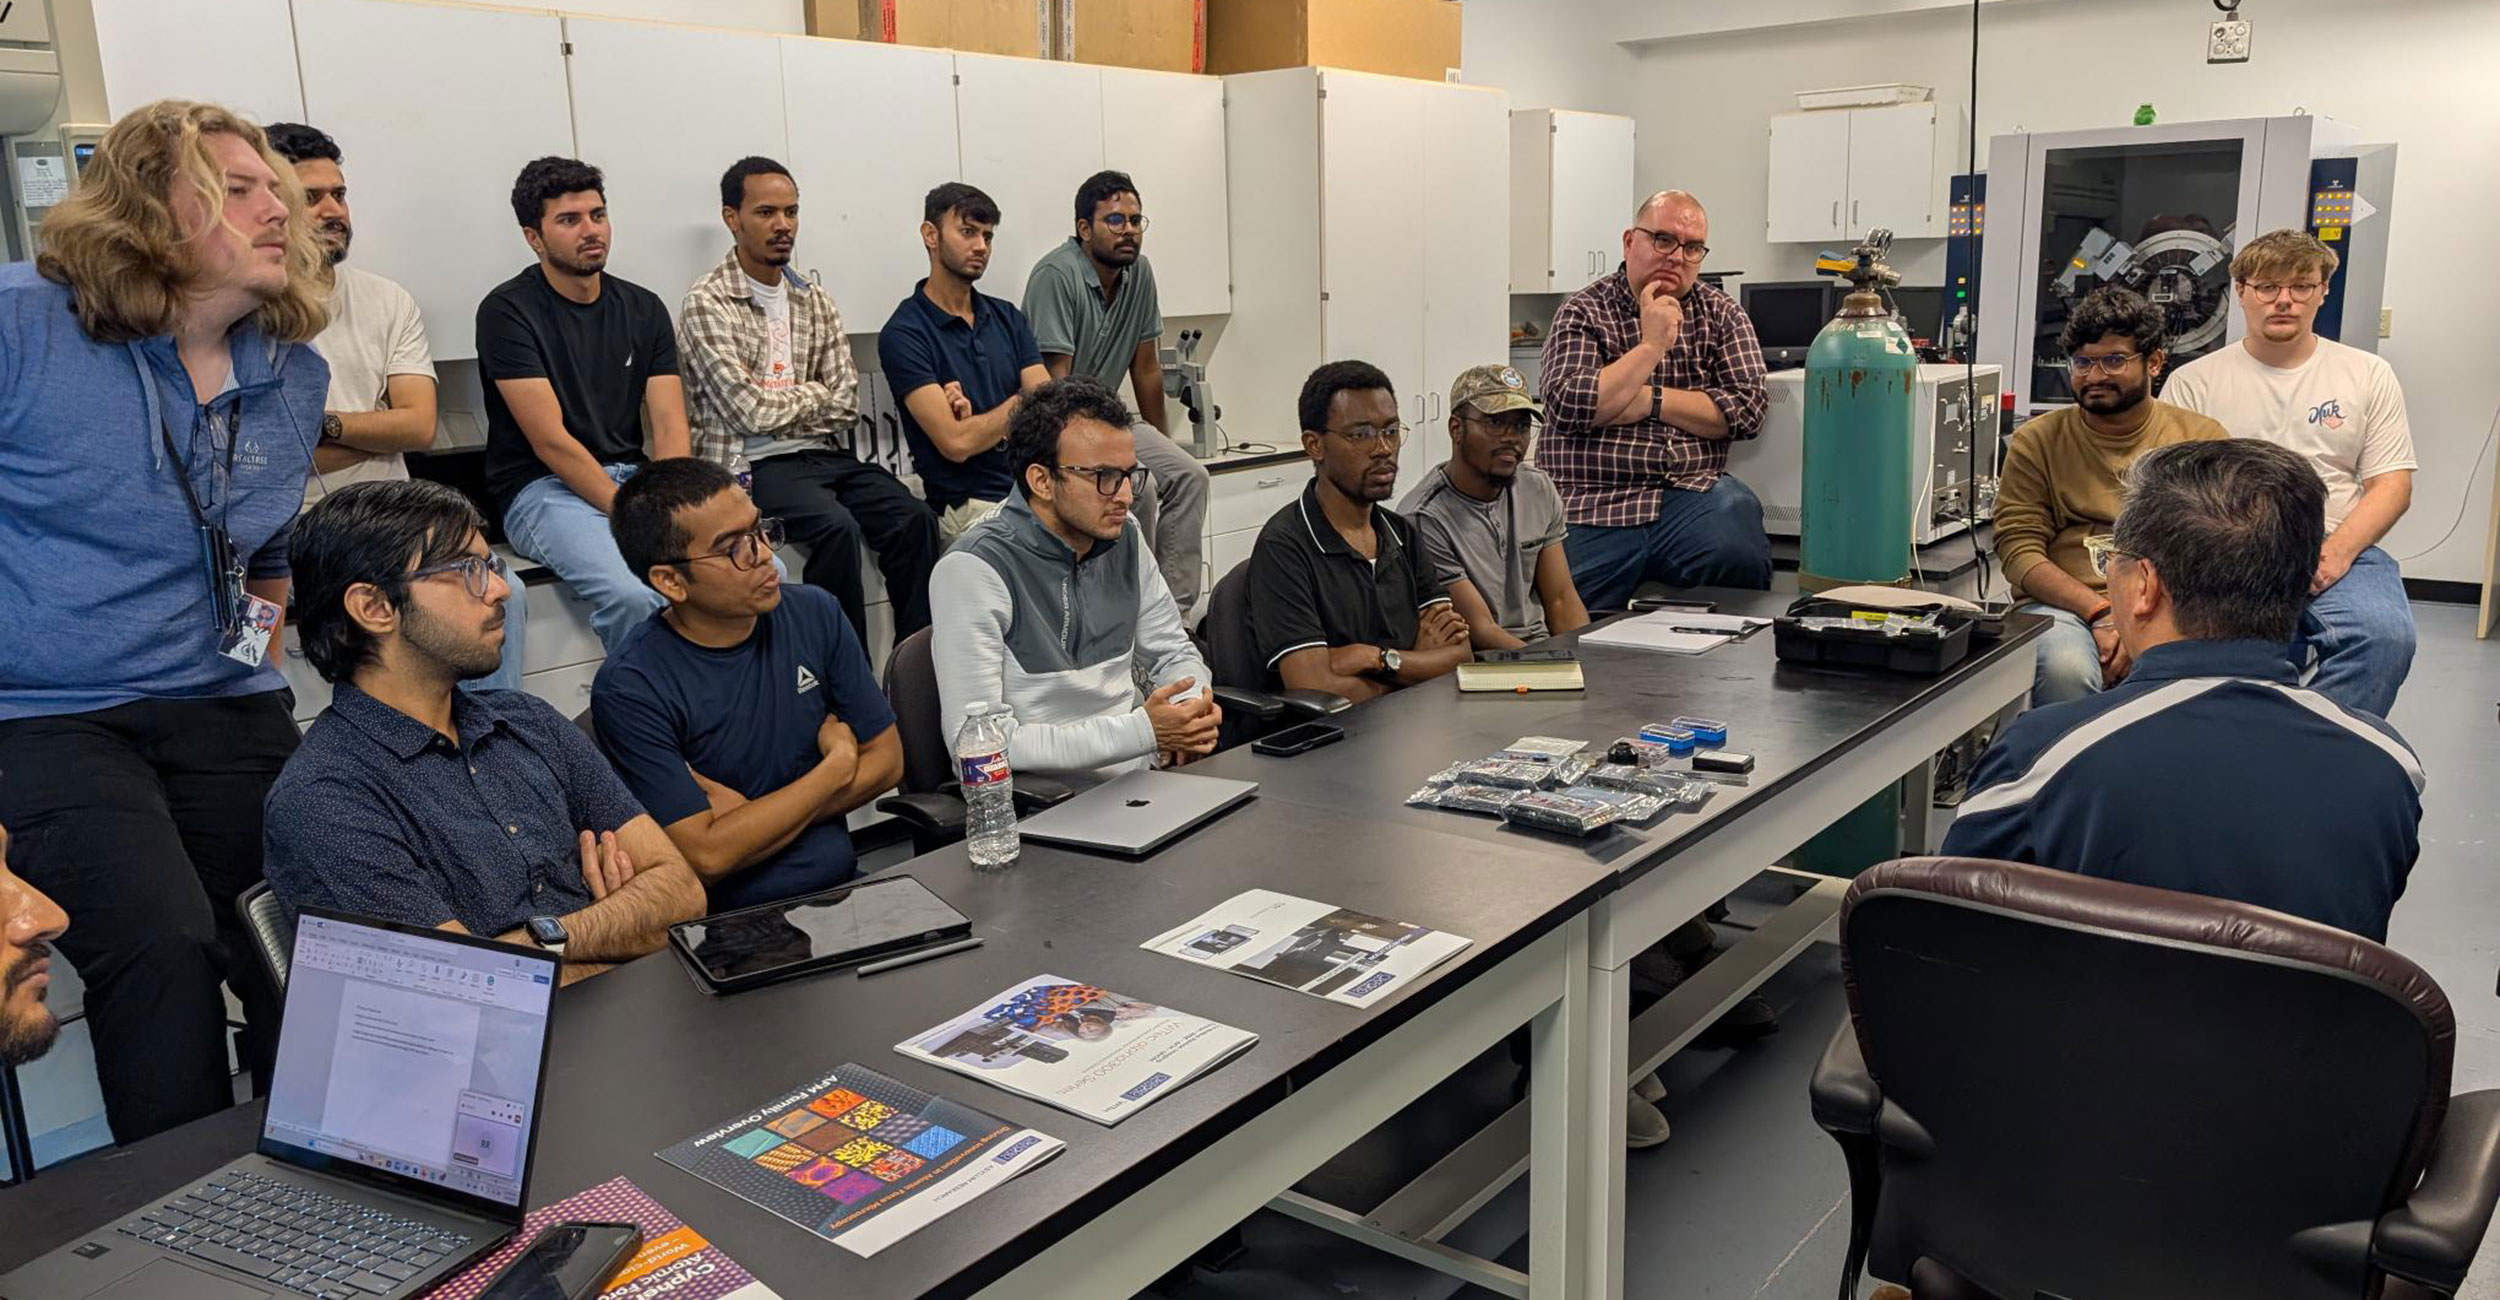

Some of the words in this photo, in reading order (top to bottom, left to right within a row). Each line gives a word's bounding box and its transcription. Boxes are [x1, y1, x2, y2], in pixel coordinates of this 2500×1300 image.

[807, 1074, 838, 1093] AFM
[759, 1092, 809, 1116] Family
[692, 1113, 765, 1146] Overview
[979, 1124, 1012, 1144] Driving
[936, 1141, 983, 1166] Innovation
[903, 1171, 933, 1190] Atomic
[880, 1187, 904, 1203] Force
[830, 1200, 880, 1230] Microscopy
[641, 1252, 702, 1285] Atomic
